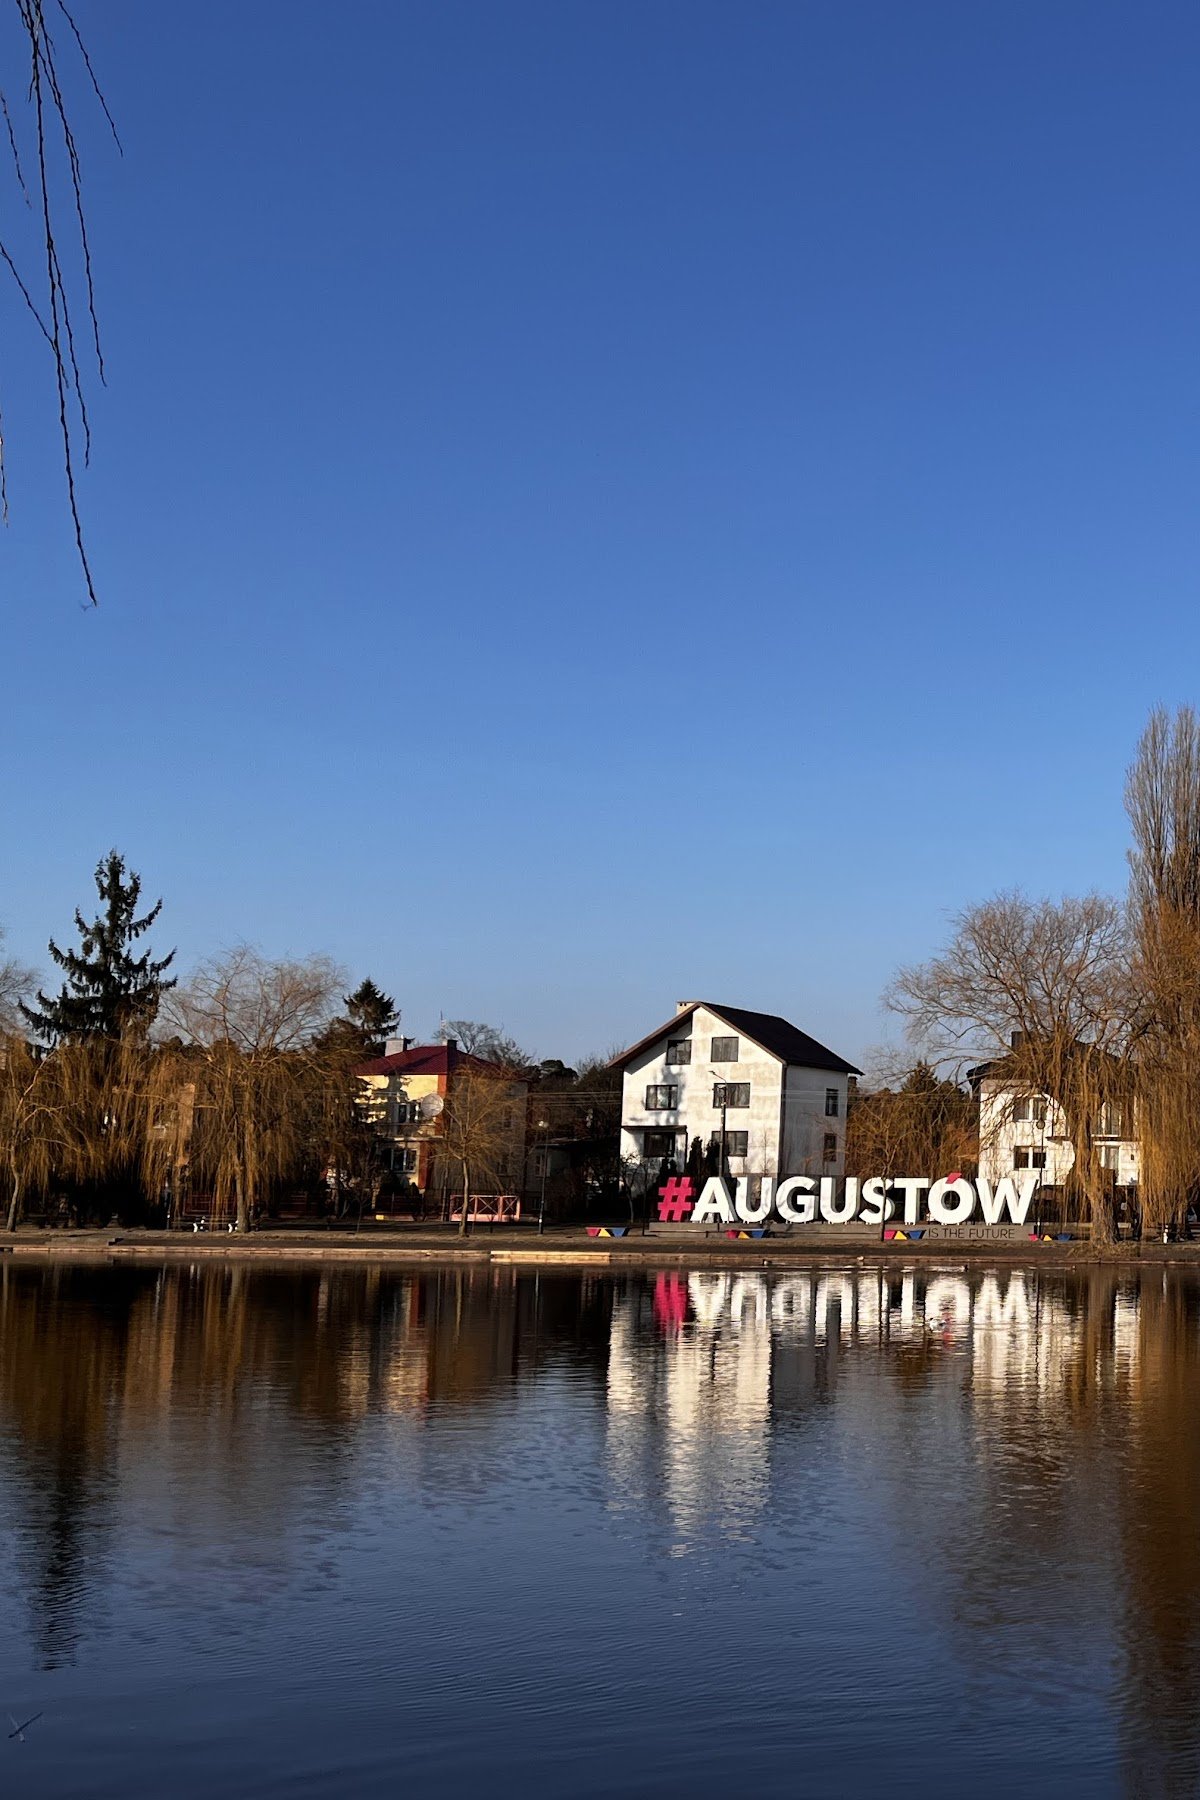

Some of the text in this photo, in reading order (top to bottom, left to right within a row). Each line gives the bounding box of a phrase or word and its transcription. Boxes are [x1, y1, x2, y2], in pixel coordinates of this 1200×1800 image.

[657, 1172, 1039, 1225] #AUGUSTÓW
[928, 1227, 1016, 1239] IS THE FUTURE
